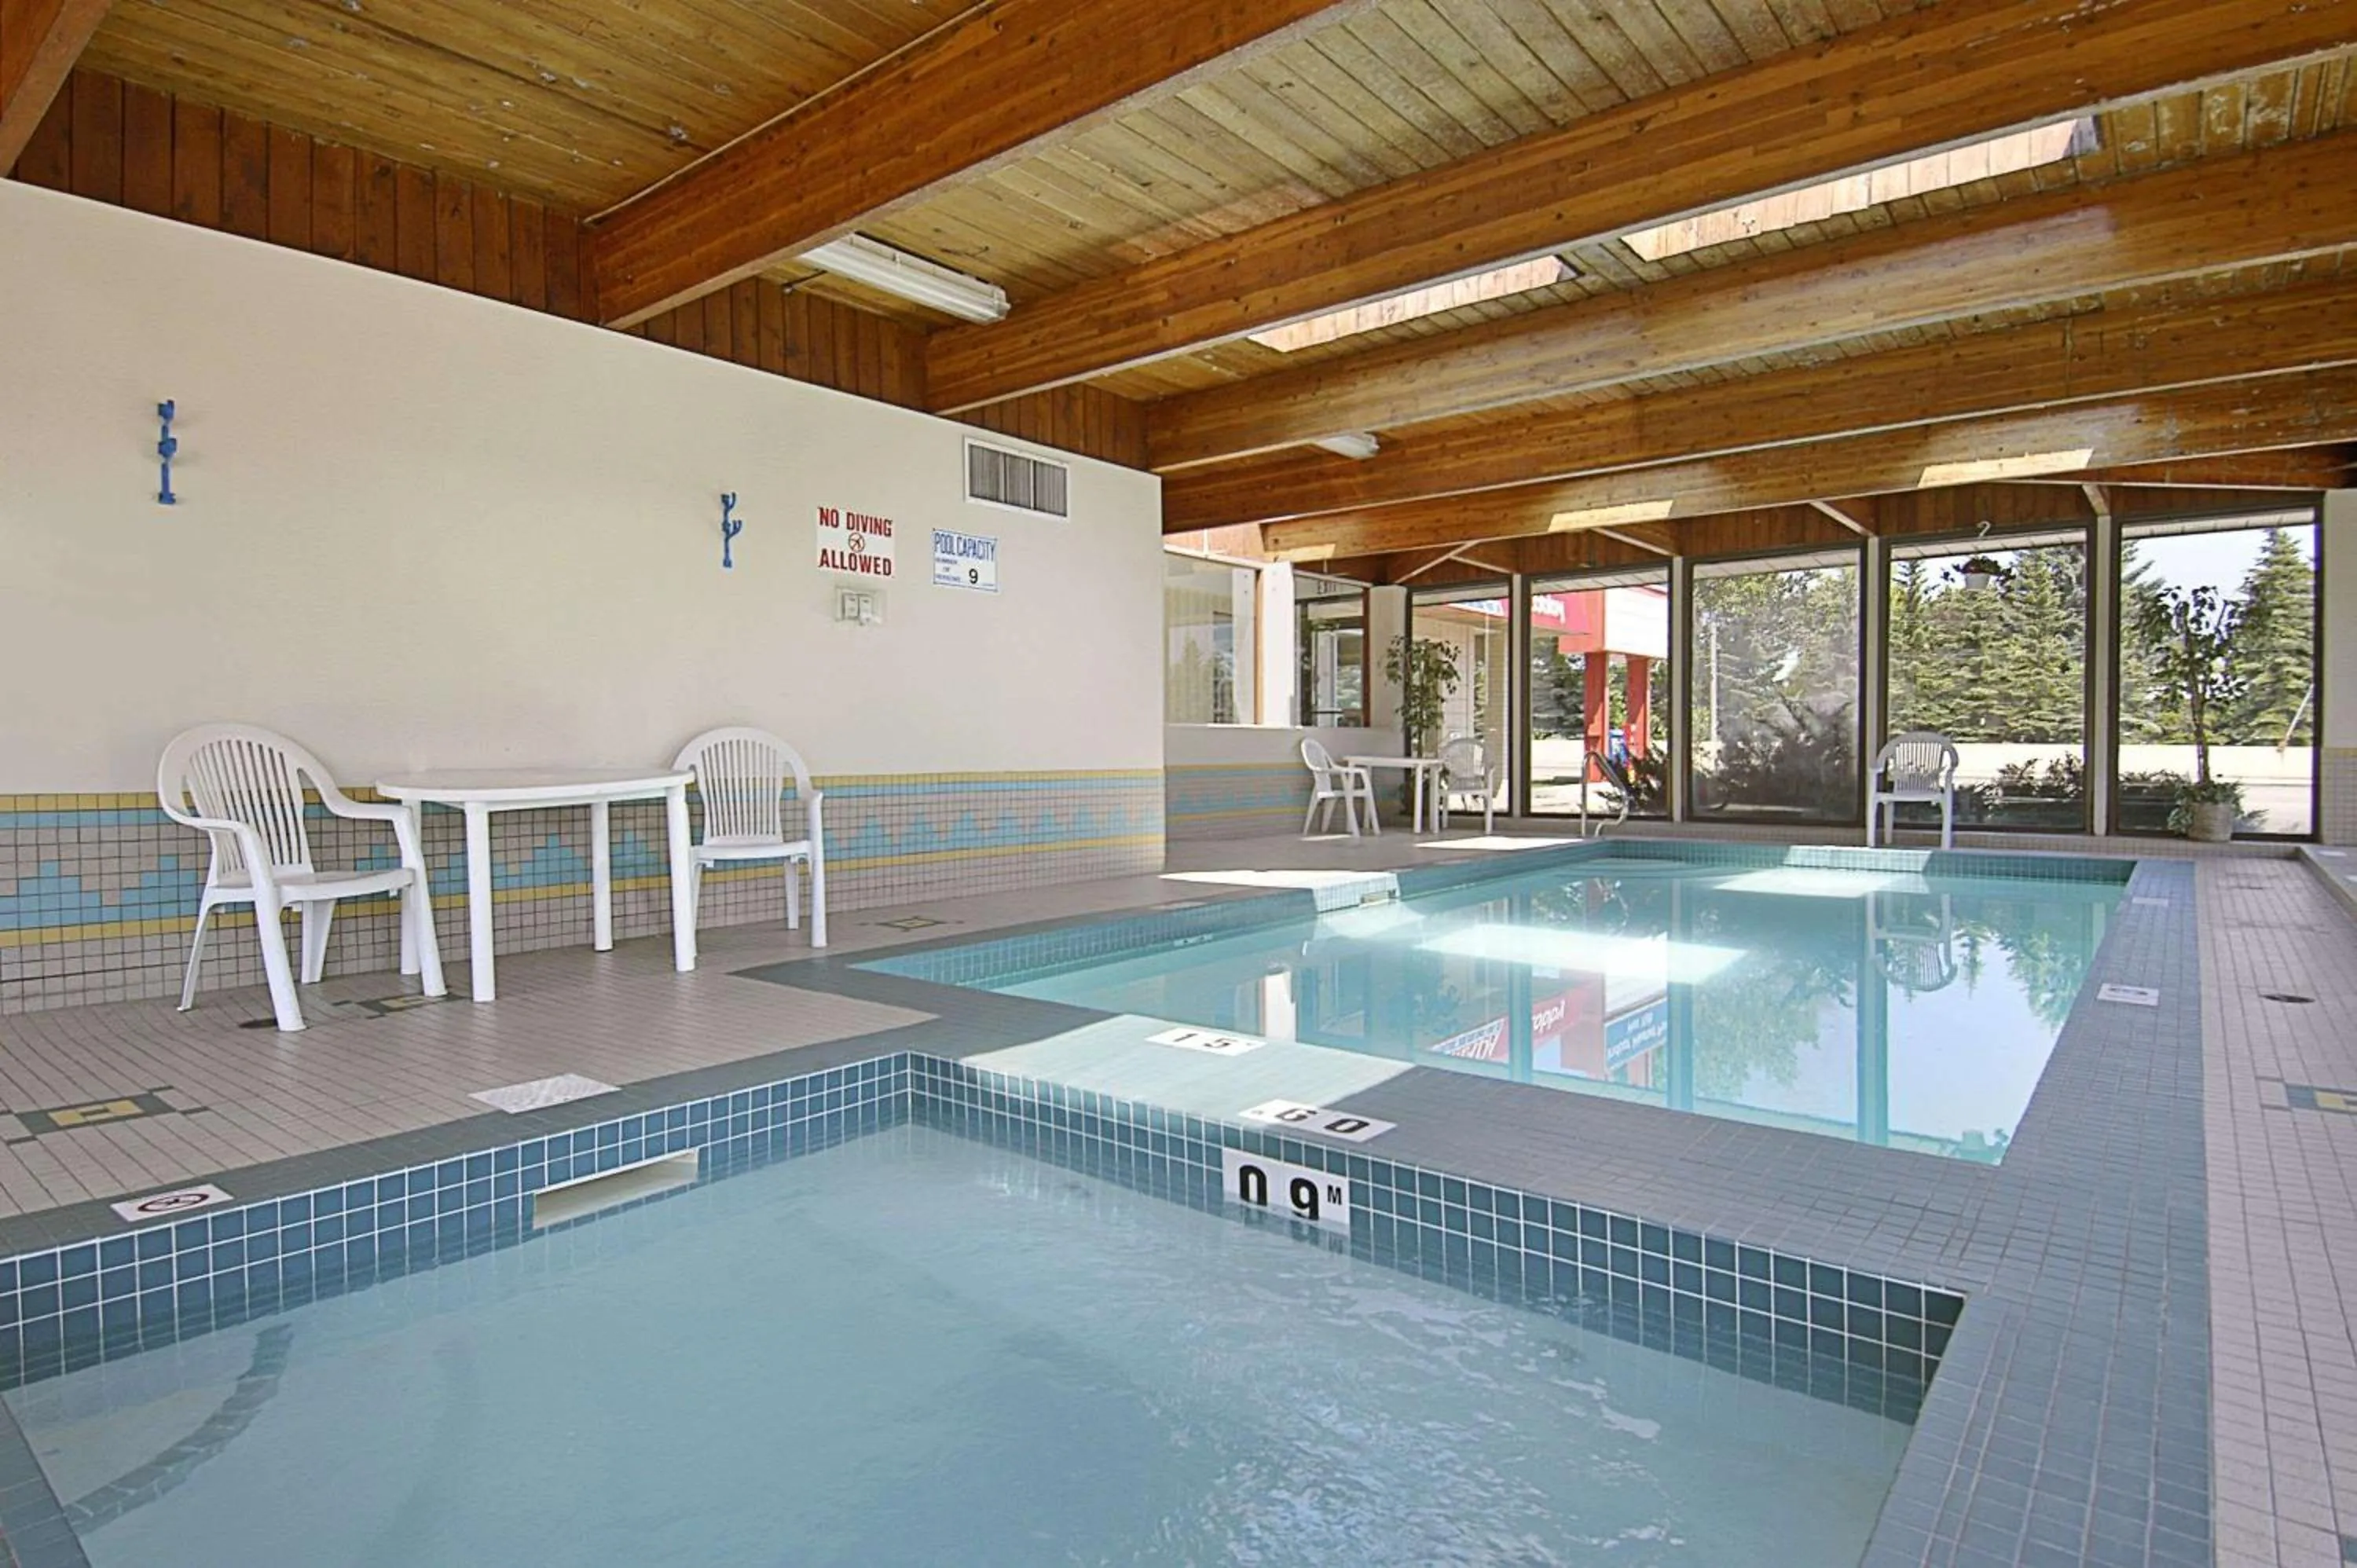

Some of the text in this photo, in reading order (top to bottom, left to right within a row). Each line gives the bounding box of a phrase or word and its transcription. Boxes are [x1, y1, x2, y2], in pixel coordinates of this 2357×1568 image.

[819, 507, 893, 537] NO DIVING
[934, 532, 996, 562] POOL CAPACITY
[818, 548, 893, 577] ALLOWED
[969, 568, 979, 584] 9
